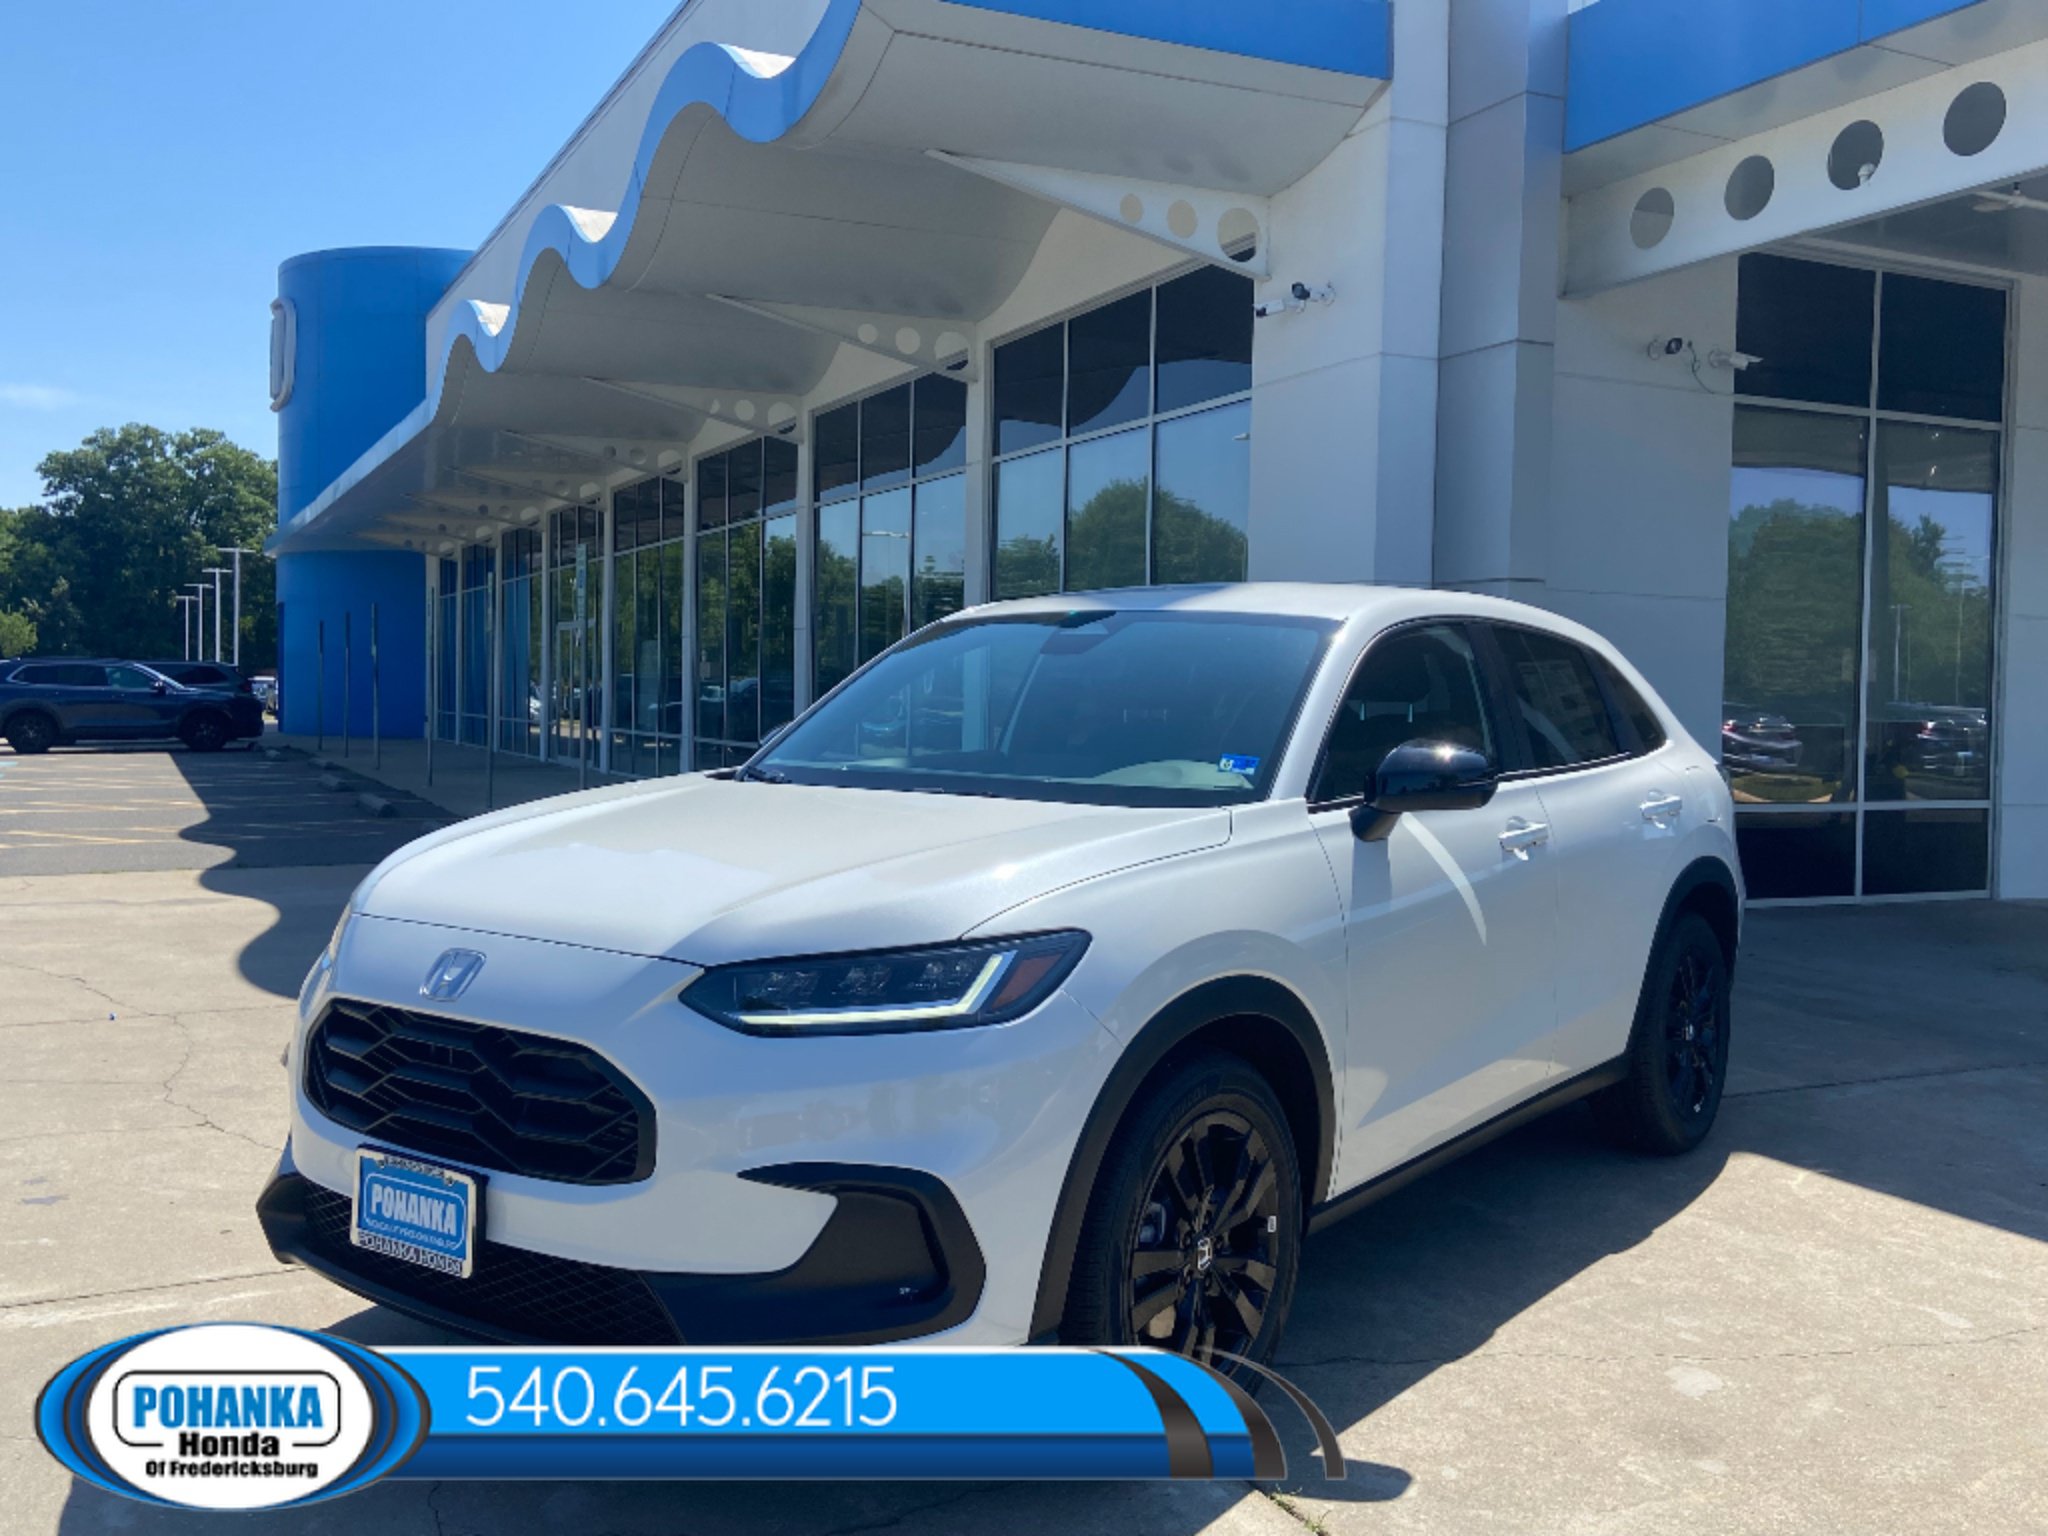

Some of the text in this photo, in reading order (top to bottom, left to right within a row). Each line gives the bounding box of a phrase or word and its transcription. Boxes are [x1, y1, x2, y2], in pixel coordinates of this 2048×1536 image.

[371, 1184, 457, 1236] POHANKA
[359, 1231, 417, 1263] POHANKA
[419, 1250, 462, 1277] HONDA
